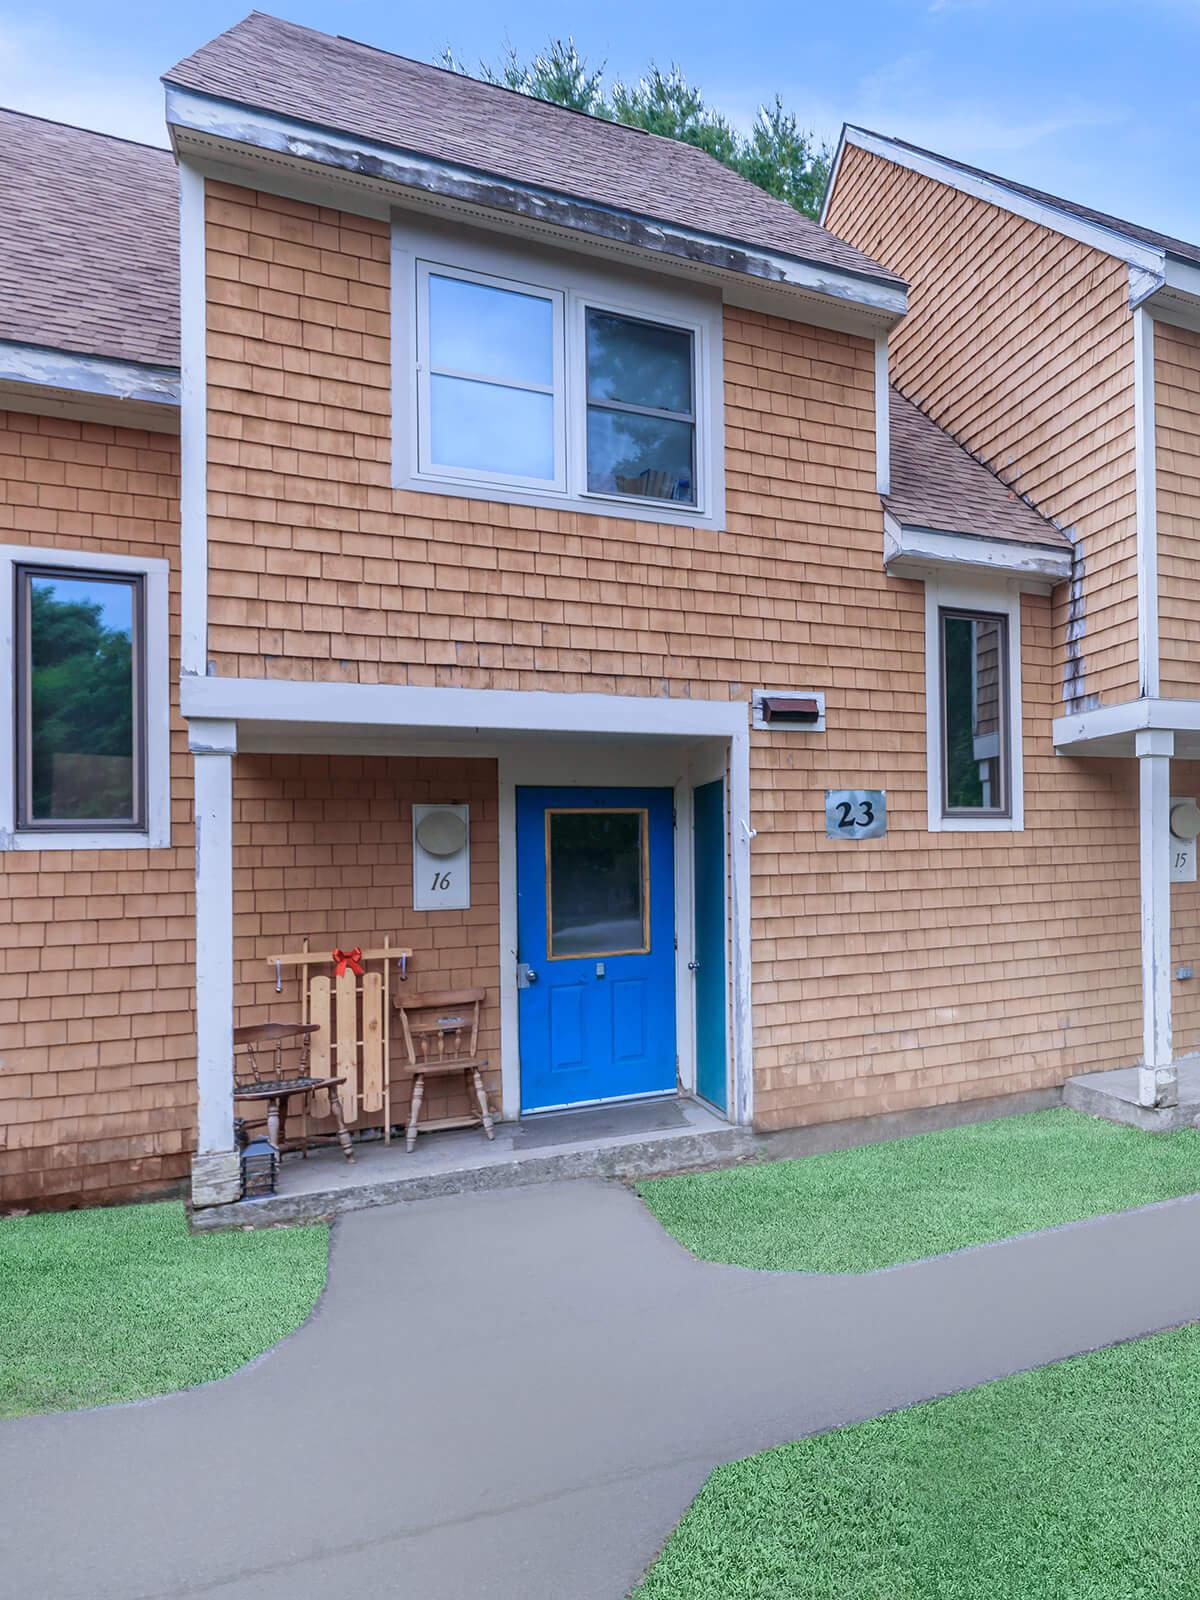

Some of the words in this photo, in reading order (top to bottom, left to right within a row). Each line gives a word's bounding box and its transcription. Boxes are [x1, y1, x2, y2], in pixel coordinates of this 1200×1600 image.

[835, 801, 875, 828] 23
[1174, 852, 1188, 868] 15
[430, 871, 452, 891] 16
